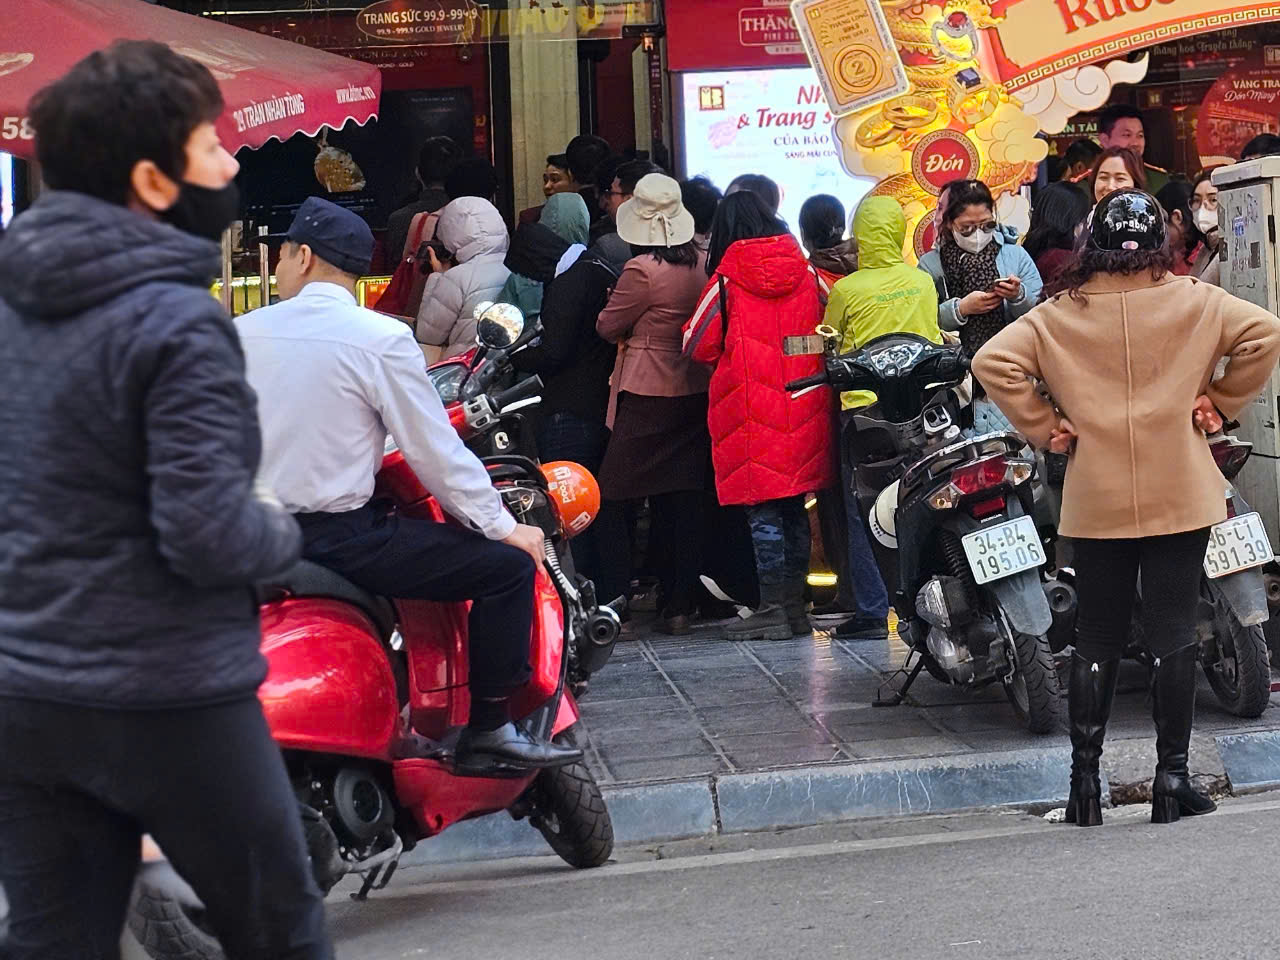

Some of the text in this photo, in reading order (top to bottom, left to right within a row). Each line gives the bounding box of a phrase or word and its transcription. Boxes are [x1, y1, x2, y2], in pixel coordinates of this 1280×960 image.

[364, 11, 399, 25] TRANG
[400, 8, 422, 24] SỨC
[1233, 79, 1260, 89] VÀNG
[757, 107, 816, 130] Trang
[926, 154, 964, 174] Đón
[976, 542, 1041, 579] 195.06
[1206, 539, 1268, 573] 591.39
